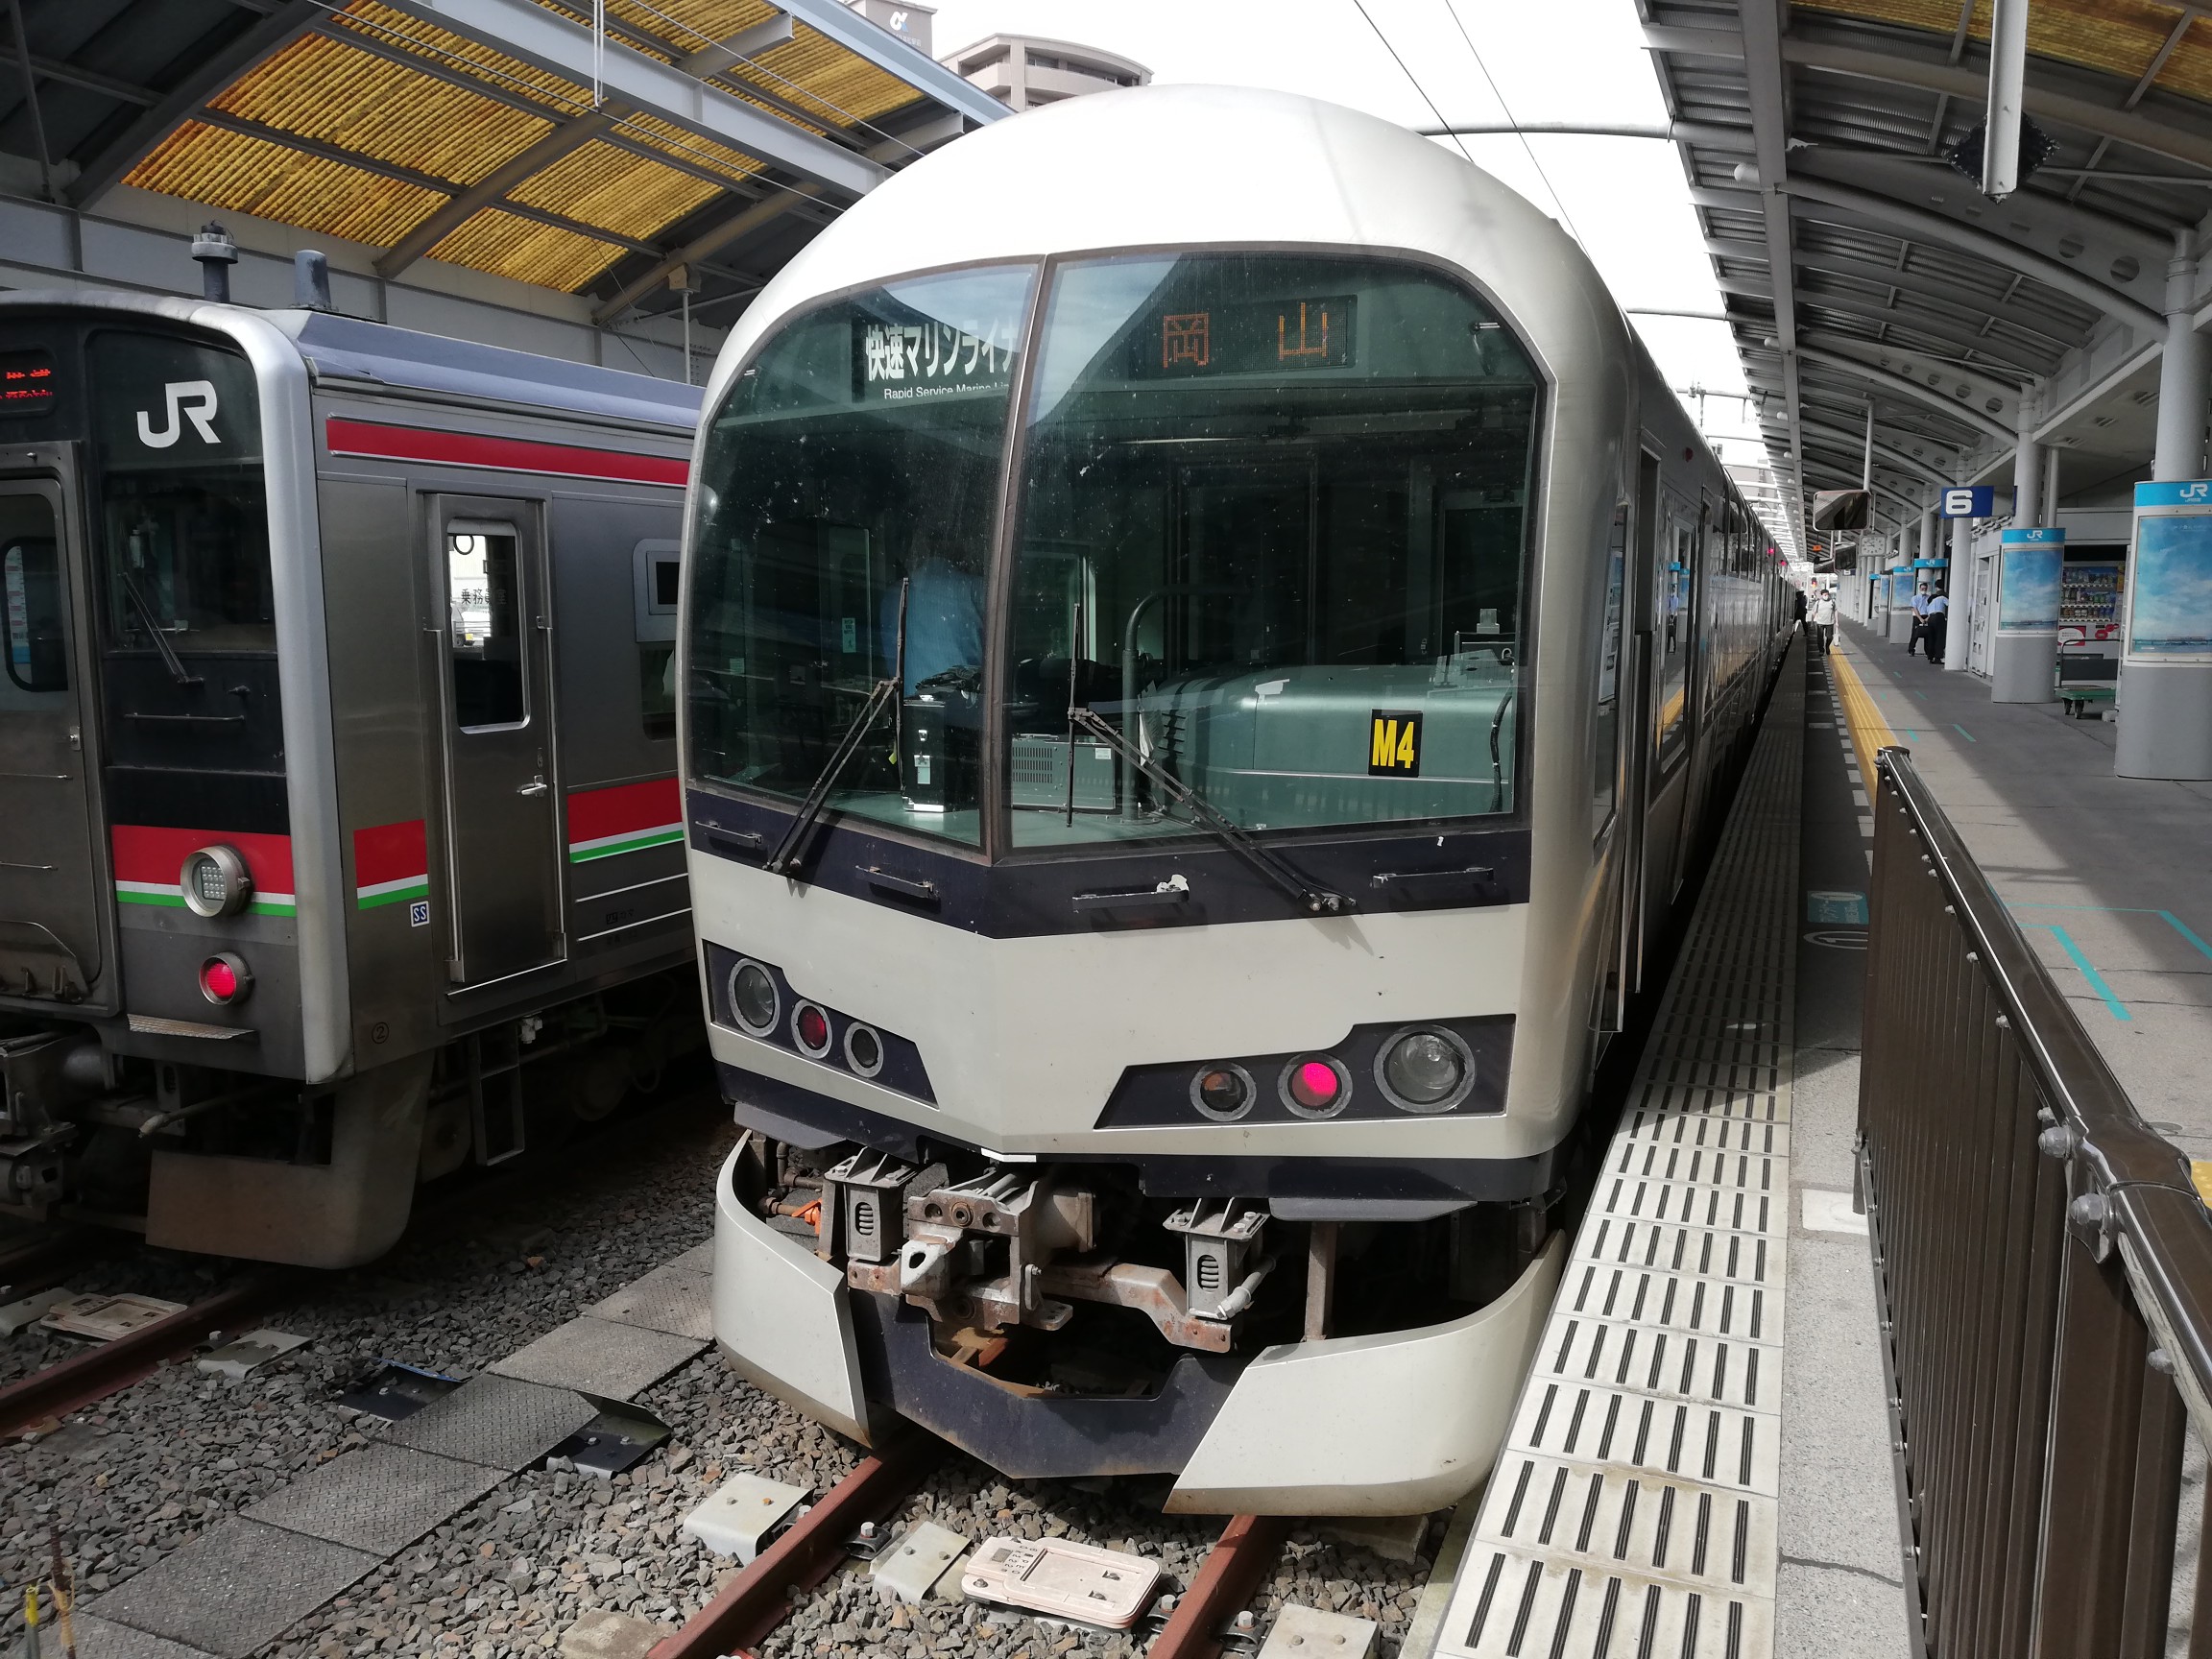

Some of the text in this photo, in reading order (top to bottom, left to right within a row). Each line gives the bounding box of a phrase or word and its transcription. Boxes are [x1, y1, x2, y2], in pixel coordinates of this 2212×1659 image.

[884, 386, 913, 399] Rapid
[916, 385, 953, 397] Service
[136, 380, 222, 448] JR
[2179, 483, 2208, 497] JR
[1945, 490, 1973, 515] 6
[2027, 530, 2043, 539] JR
[1372, 718, 1415, 769] M4
[413, 905, 427, 923] SS
